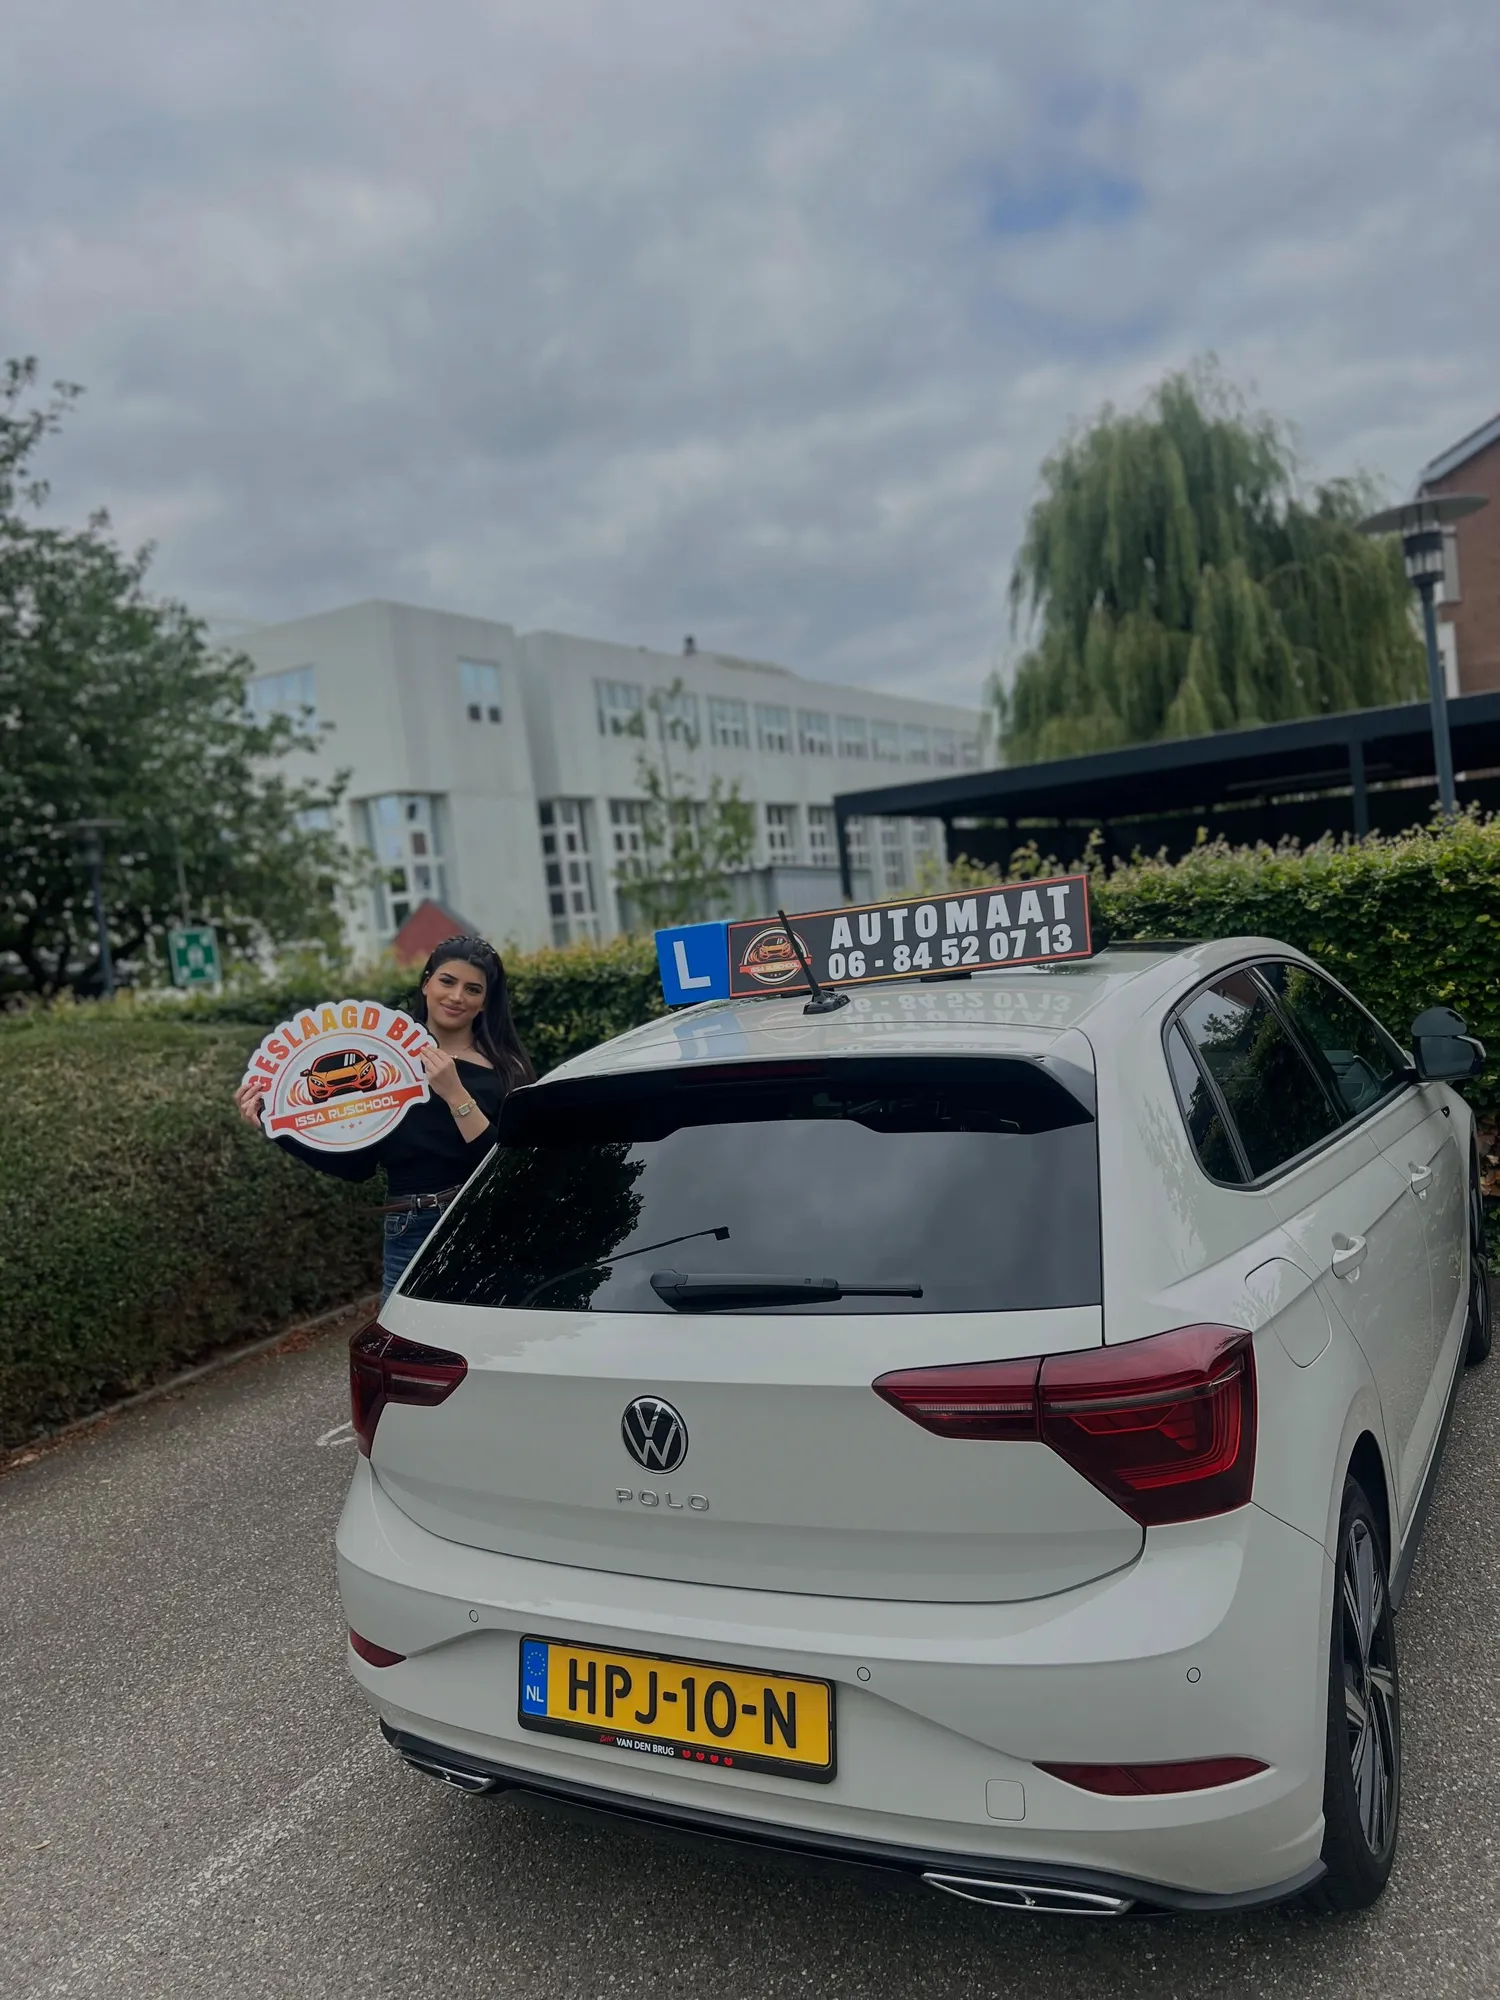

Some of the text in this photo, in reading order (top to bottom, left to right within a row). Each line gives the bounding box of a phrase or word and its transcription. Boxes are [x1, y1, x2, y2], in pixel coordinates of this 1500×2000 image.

[830, 885, 1070, 949] AUTOMAAT
[673, 940, 711, 990] L
[828, 950, 866, 980] 06
[892, 942, 932, 973] 84
[941, 935, 980, 967] 52
[988, 929, 1027, 961] 07
[1036, 923, 1073, 954] 13
[247, 1005, 380, 1093] GESLAAGD
[294, 1112, 326, 1127] ISSA
[615, 1486, 710, 1511] POLO
[526, 1684, 545, 1703] NL
[568, 1658, 796, 1749] HPJ-10-N
[616, 1737, 633, 1749] VAN
[634, 1741, 651, 1752] DEN
[652, 1744, 675, 1756] BRUG
